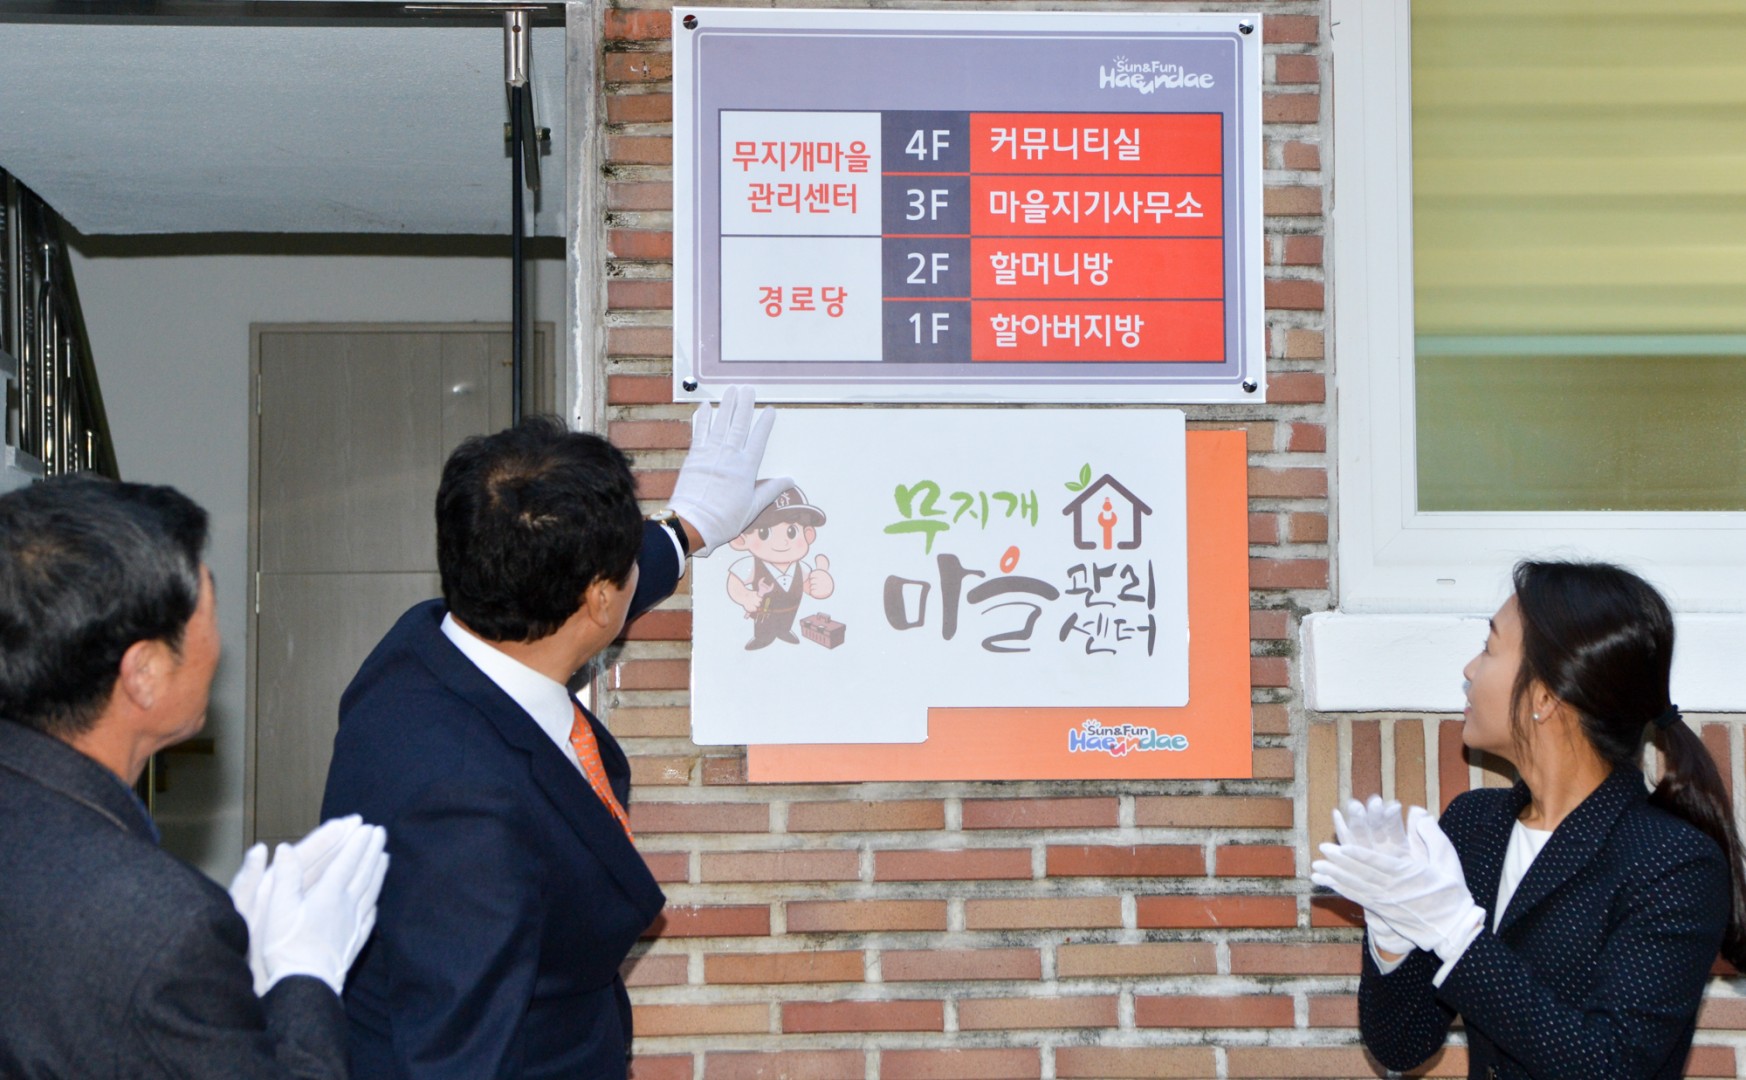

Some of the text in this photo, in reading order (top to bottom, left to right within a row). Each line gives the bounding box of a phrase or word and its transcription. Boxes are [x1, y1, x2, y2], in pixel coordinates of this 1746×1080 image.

[1099, 65, 1215, 95] Haeundae
[1117, 60, 1177, 73] Sun&Fun
[732, 140, 871, 173] 무지개마을
[905, 129, 950, 161] 4F
[990, 128, 1142, 162] 커뮤니티실
[747, 183, 858, 214] 관리센터
[906, 189, 949, 221] 3F
[990, 190, 1204, 224] 마을지기사무소
[906, 252, 950, 284] 2F
[990, 251, 1113, 286] 할머니방
[758, 286, 848, 318] 경로당
[908, 312, 950, 344] 1F
[990, 313, 1144, 348] 할아버지방
[883, 480, 1038, 555] 무지개
[883, 545, 1060, 653] 마을
[1065, 559, 1156, 610] 관리
[1059, 612, 1156, 657] 센터
[1069, 729, 1187, 756] Haeundae
[1087, 725, 1148, 736] Sun&Fun
